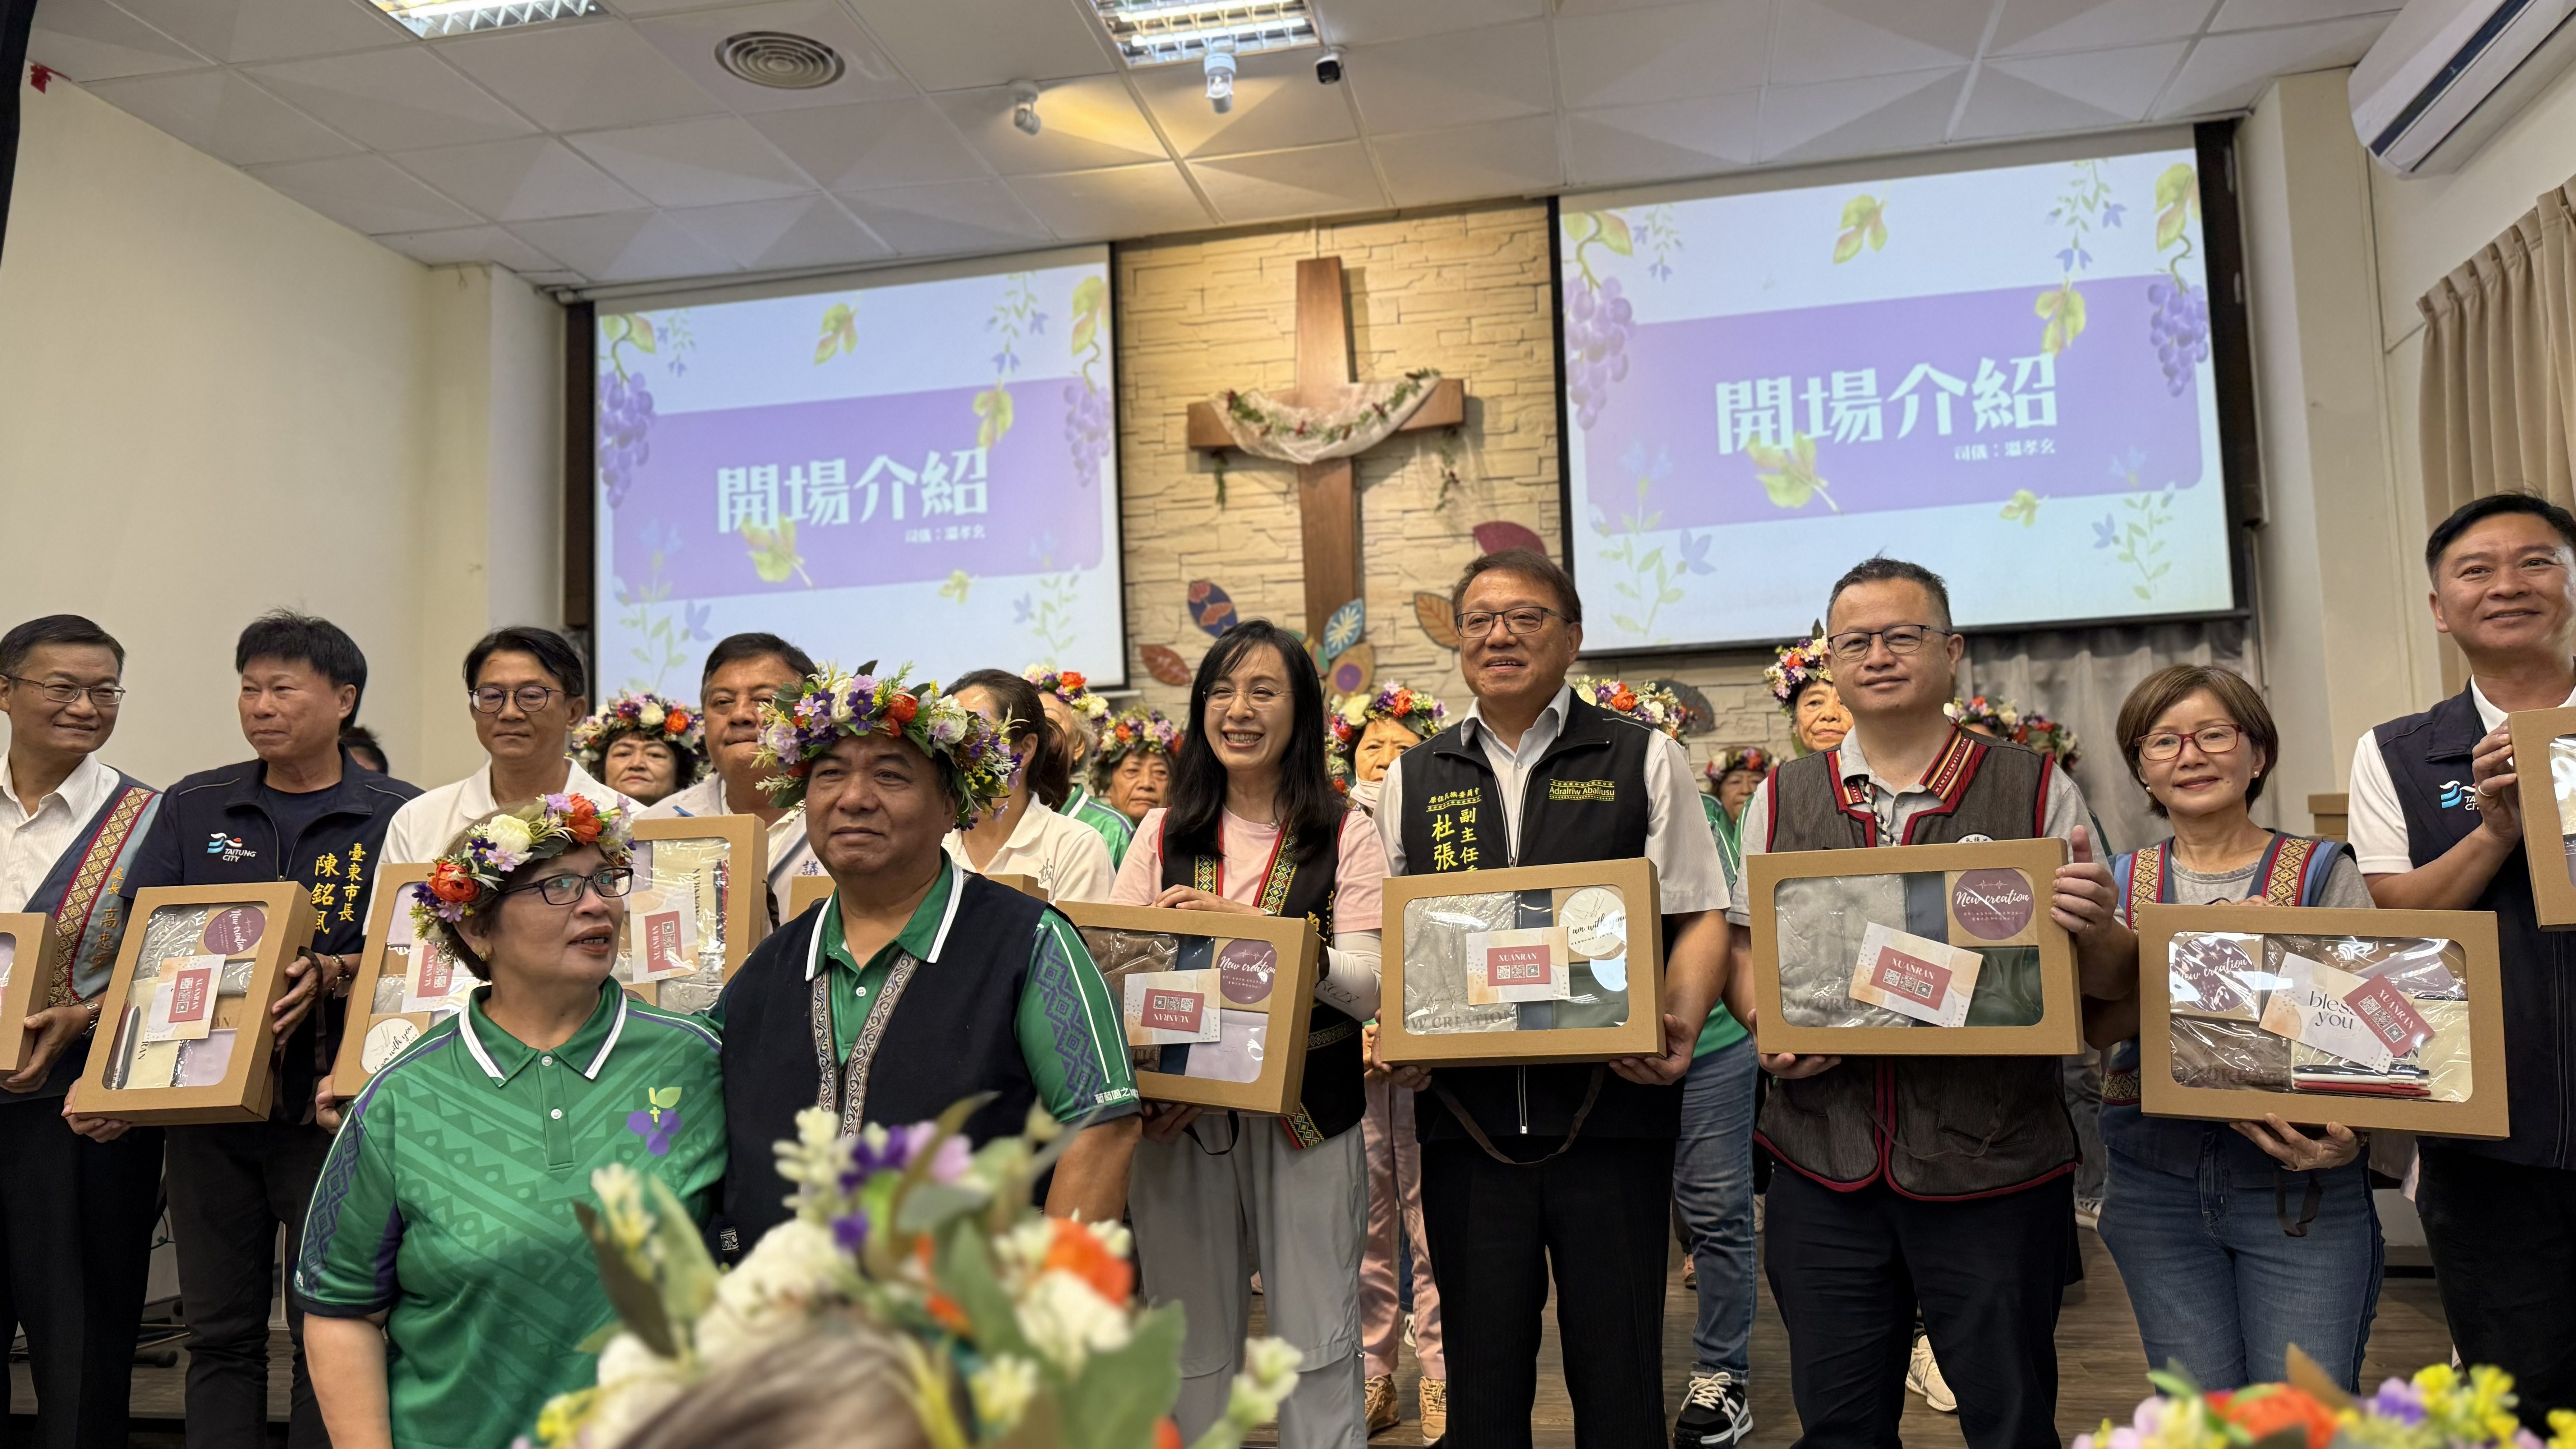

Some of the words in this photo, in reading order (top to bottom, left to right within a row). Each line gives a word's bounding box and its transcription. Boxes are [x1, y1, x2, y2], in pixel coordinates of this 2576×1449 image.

[1716, 353, 2057, 455] 開場介紹
[718, 446, 988, 534] 開場介紹
[225, 848, 257, 857] TAITUNG
[338, 842, 367, 922] 臺東市長
[1956, 891, 1981, 907] New
[1985, 889, 2030, 905] creation
[1220, 956, 1240, 970] New
[1242, 961, 1276, 974] creation
[1499, 952, 1536, 961] XUANRAN
[1891, 958, 1935, 980] XUANRAN
[2203, 957, 2248, 977] creation
[191, 978, 204, 1010] XUANRAN
[1154, 1013, 1189, 1023] XUANRAN
[2378, 989, 2415, 1029] XUANRAN
[2315, 1012, 2353, 1030] you
